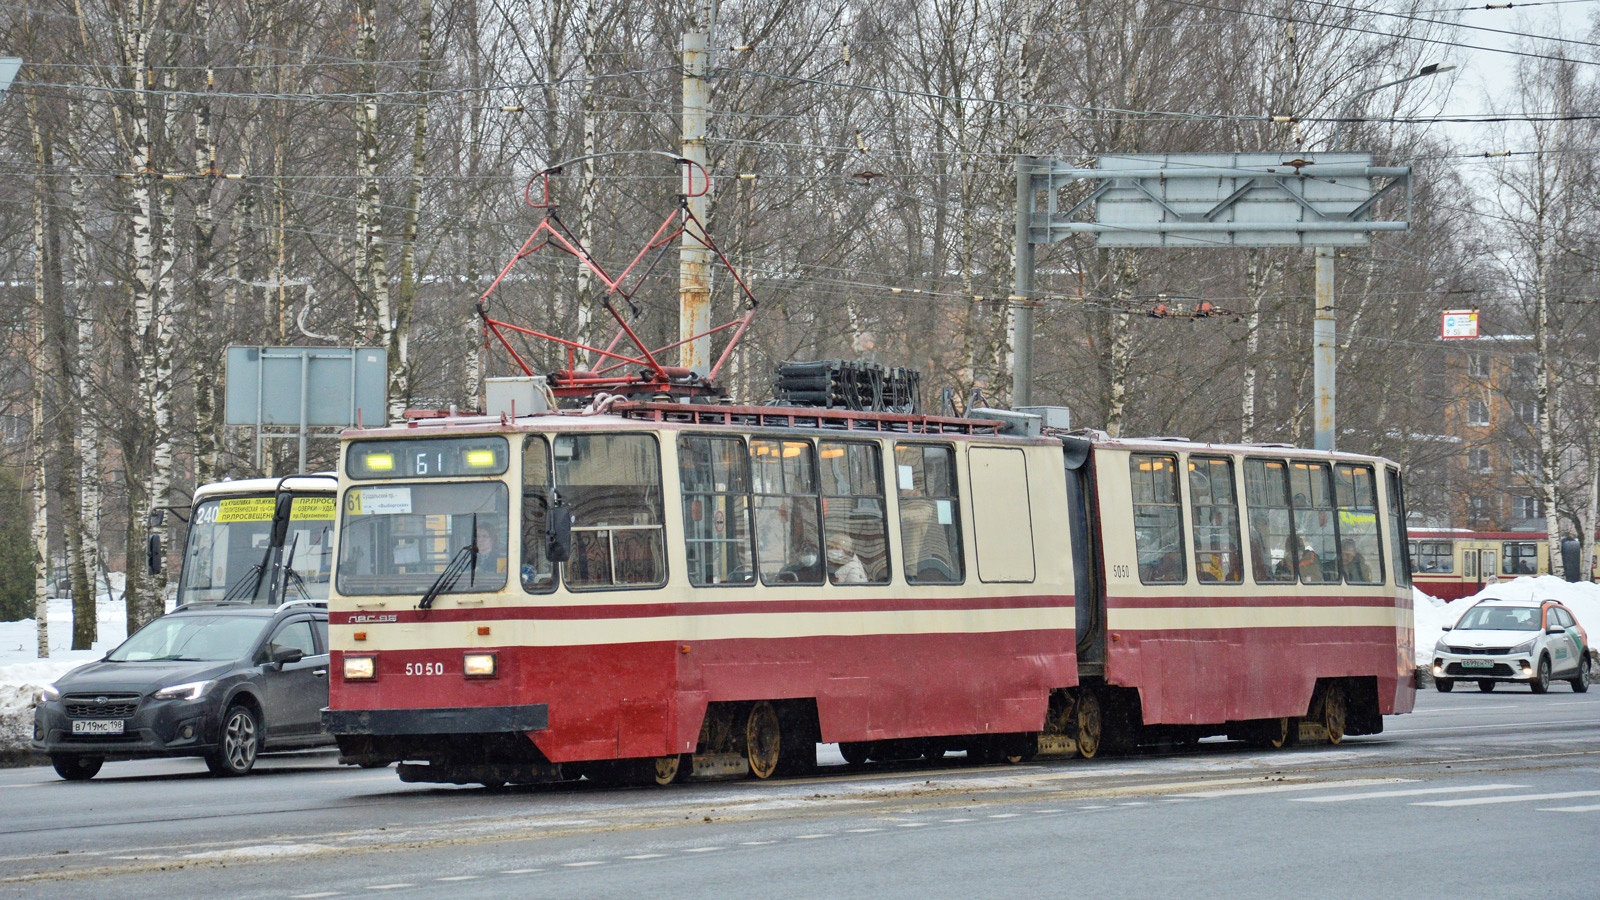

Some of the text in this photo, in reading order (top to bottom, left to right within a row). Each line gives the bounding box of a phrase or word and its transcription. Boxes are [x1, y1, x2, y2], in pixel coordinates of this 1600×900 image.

[416, 453, 442, 475] 61
[347, 493, 361, 511] 61
[195, 506, 219, 525] 240
[1113, 564, 1130, 578] 5050
[405, 662, 444, 676] 5050
[75, 720, 122, 731] В719МС 198
